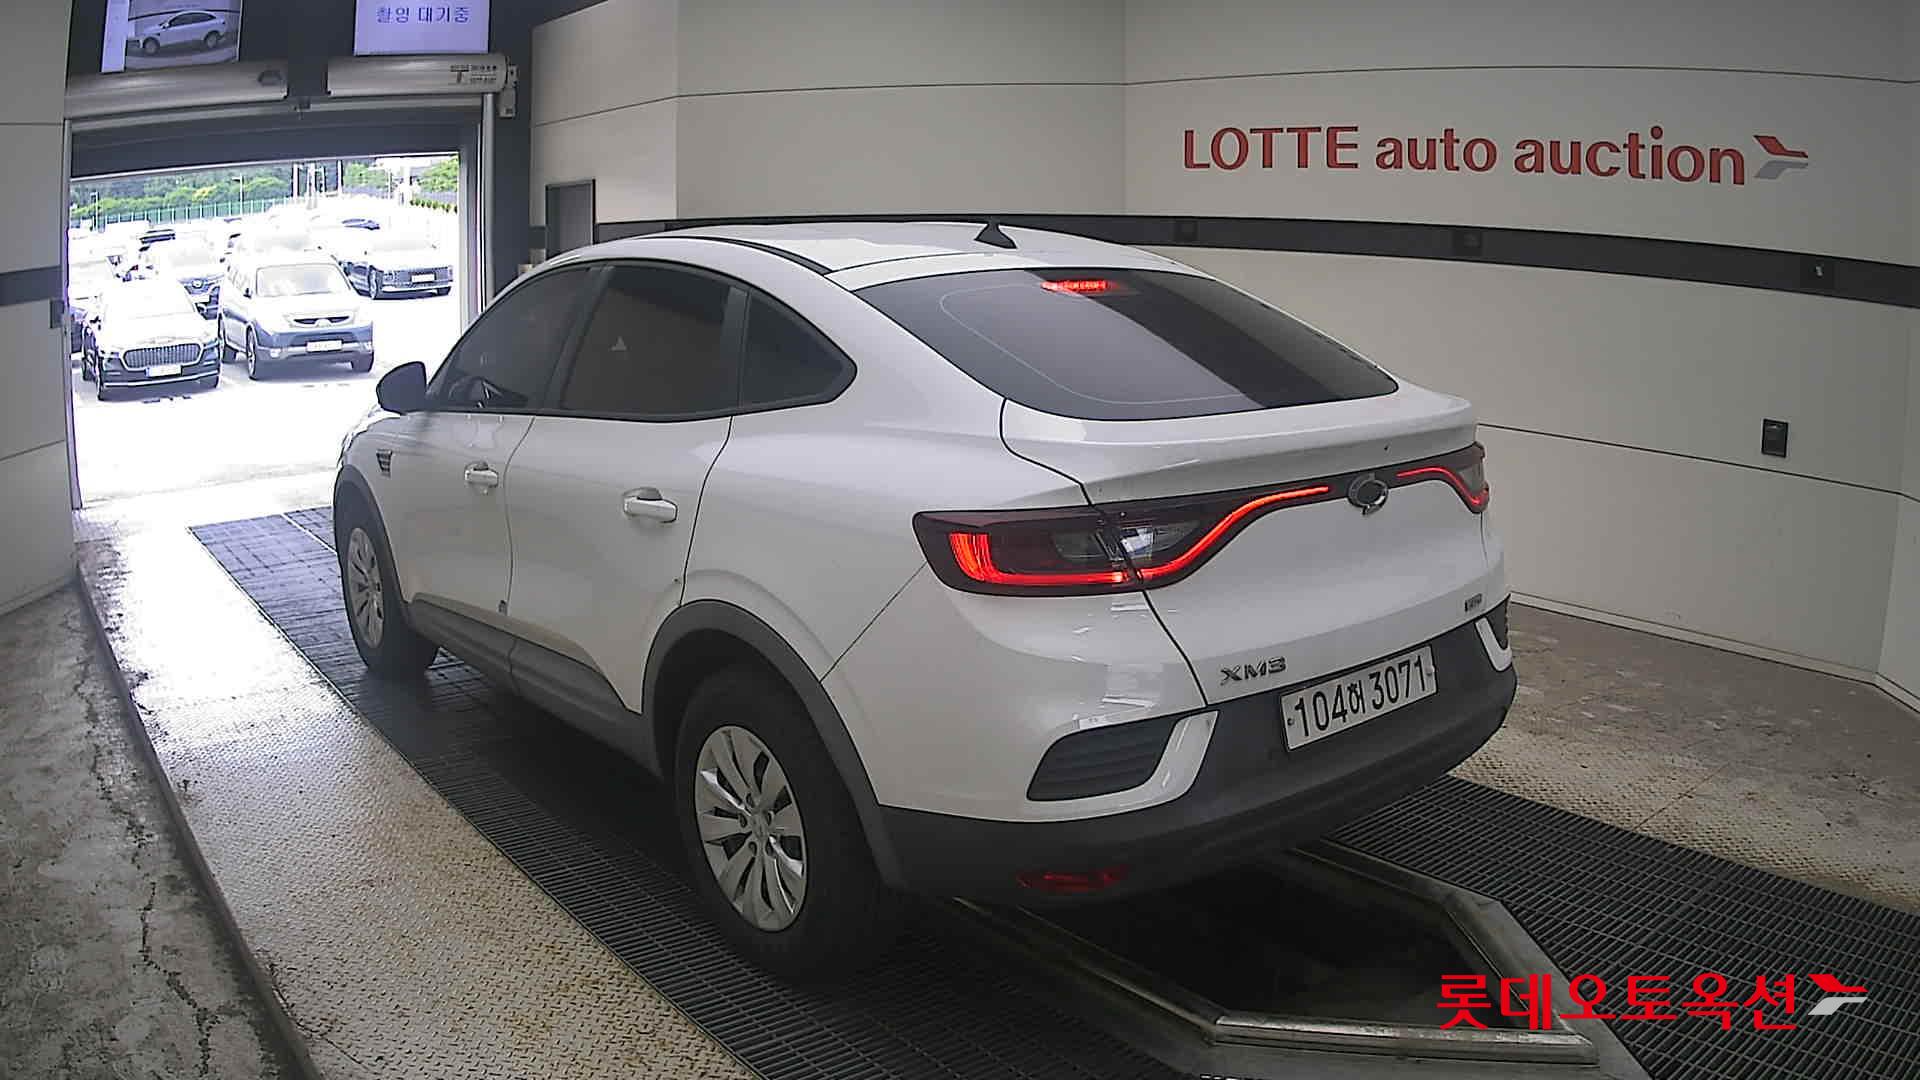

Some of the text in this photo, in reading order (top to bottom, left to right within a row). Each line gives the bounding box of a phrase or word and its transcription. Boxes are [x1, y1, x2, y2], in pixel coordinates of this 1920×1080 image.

[418, 6, 470, 23] 대기중
[1183, 126, 1745, 185] LOTTE auto auction
[1220, 656, 1287, 685] XM3
[1294, 655, 1426, 737] 104허 3071
